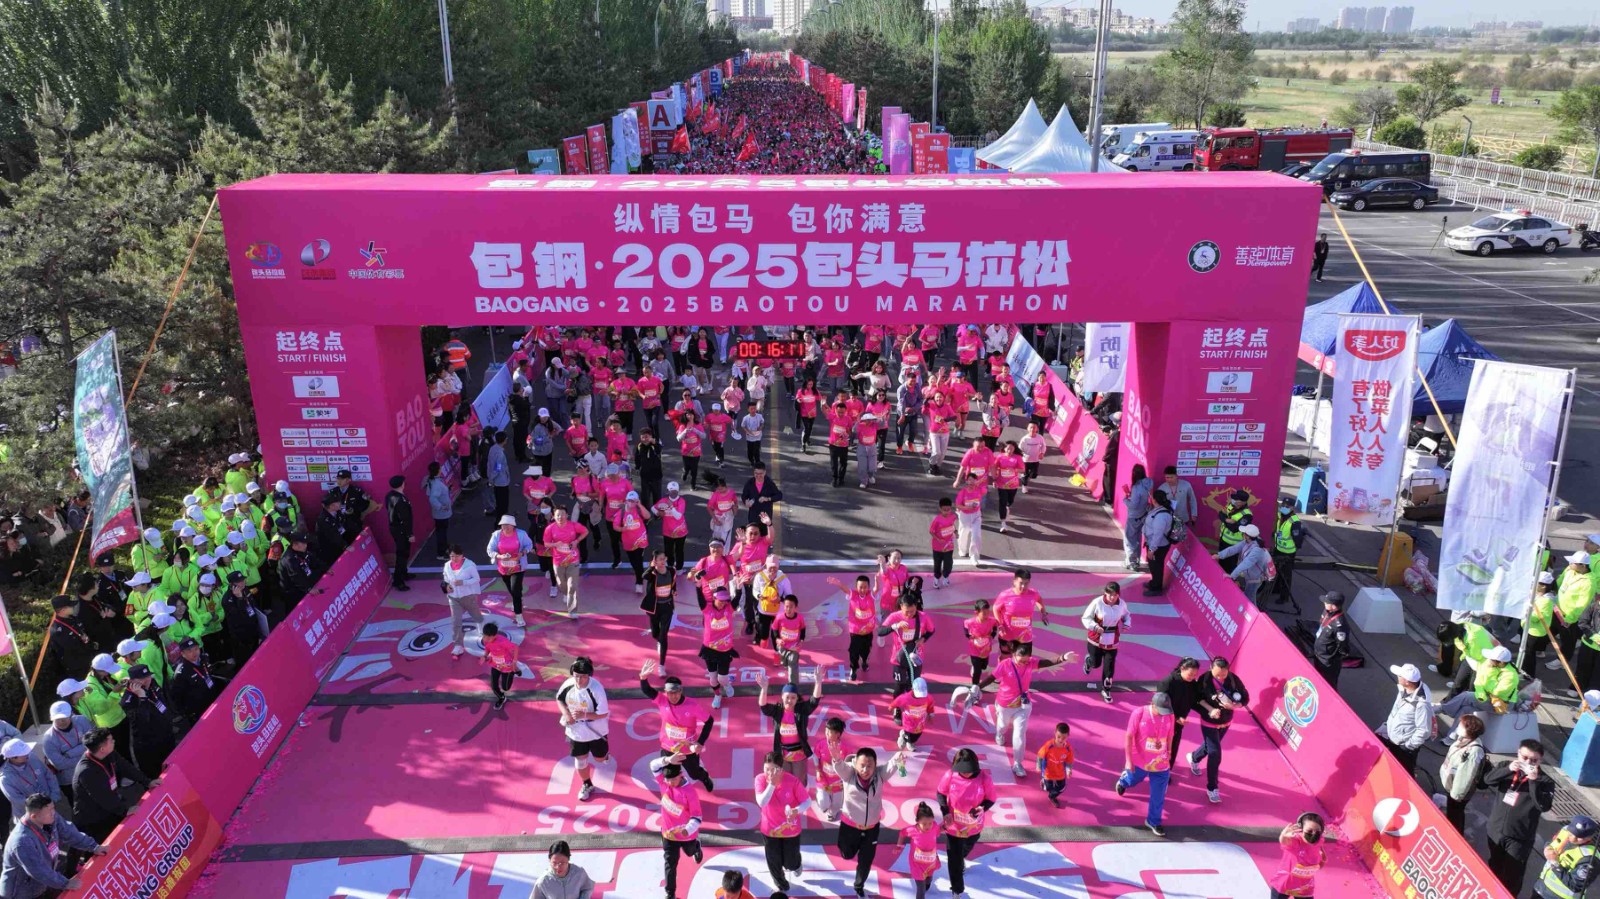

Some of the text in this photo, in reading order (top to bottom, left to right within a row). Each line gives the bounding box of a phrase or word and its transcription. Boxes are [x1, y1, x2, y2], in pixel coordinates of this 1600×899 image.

[710, 71, 719, 83] B
[652, 104, 671, 127] A
[613, 202, 926, 233] 纵情包马 包你满意
[1235, 246, 1295, 265] 善跑体育
[475, 296, 589, 313] BAOGANG
[876, 294, 1067, 312] MARATHON
[275, 331, 345, 351] 起终点
[1202, 328, 1269, 348] 起终点
[893, 672, 901, 682] 21
[156, 824, 195, 877] GROUP
